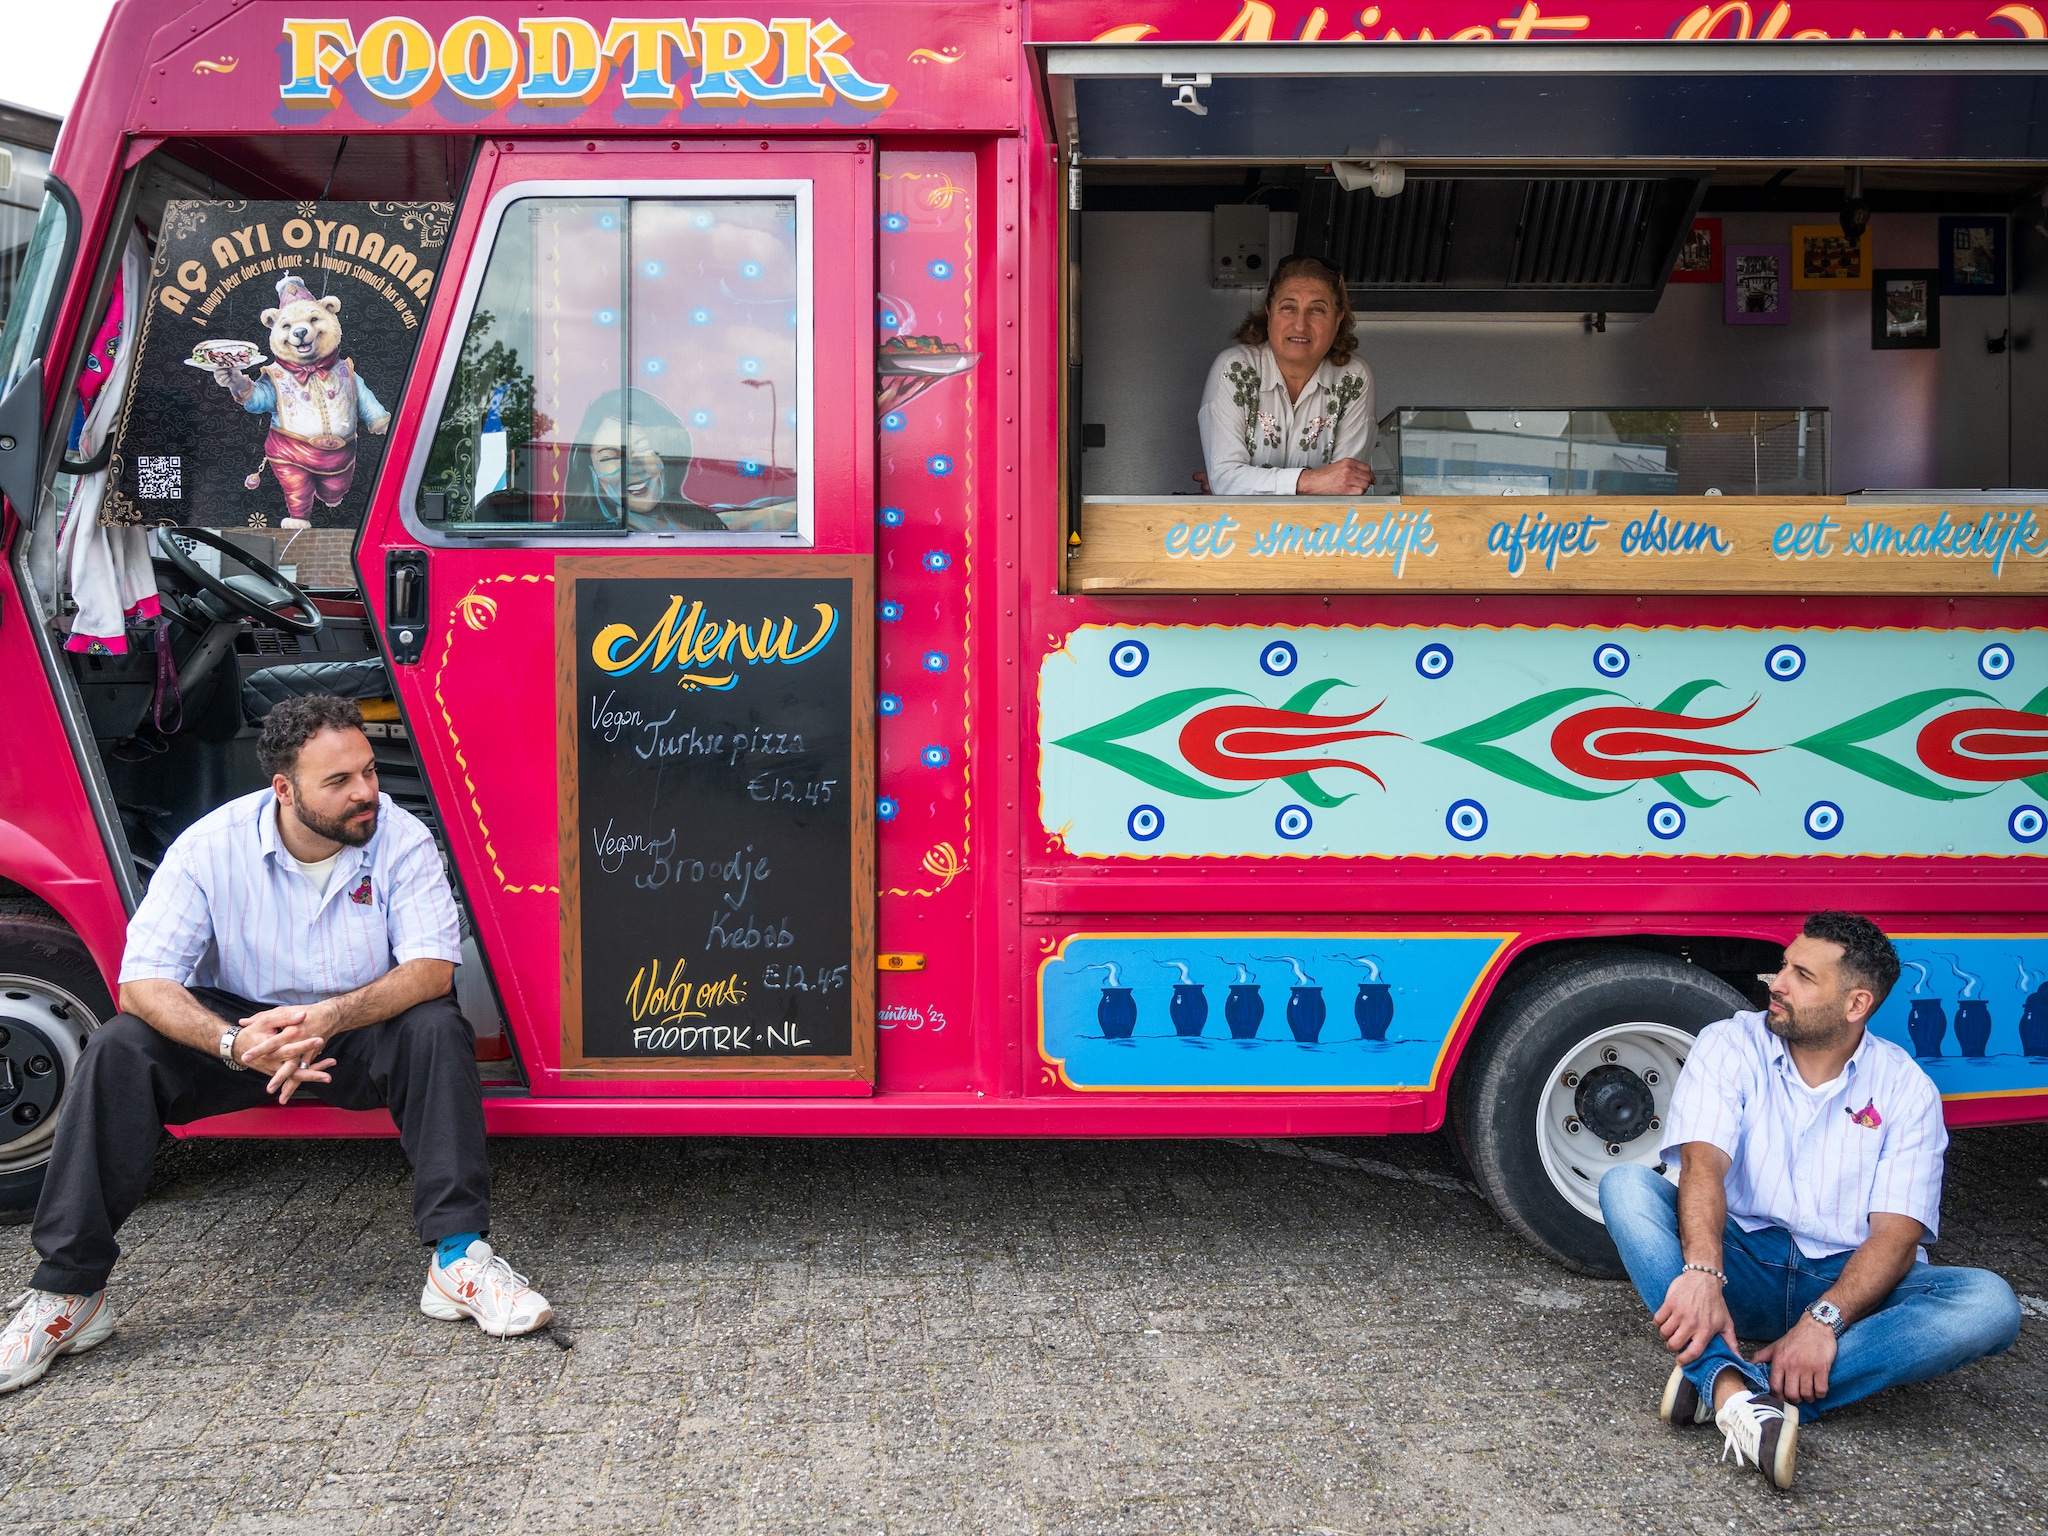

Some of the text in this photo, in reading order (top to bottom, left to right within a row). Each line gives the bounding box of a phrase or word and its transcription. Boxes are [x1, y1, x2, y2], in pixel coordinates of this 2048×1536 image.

[279, 15, 895, 108] FOODTRK
[191, 253, 302, 327] A hungry bear does not dance
[211, 223, 271, 269] AYI
[282, 218, 435, 307] OYNAMA
[312, 252, 418, 330] A hungry stomach has no ears
[1165, 507, 2048, 580] eet smakelijk afiyet olsun eet smakelijk
[592, 595, 839, 677] Menu
[592, 690, 644, 742] Vegan
[729, 726, 805, 766] pizza
[593, 818, 652, 873] Vegan
[635, 828, 771, 910] Broodje
[706, 911, 794, 950] Kebab
[626, 958, 748, 1025] Volg ons:
[877, 1004, 924, 1030] ainters
